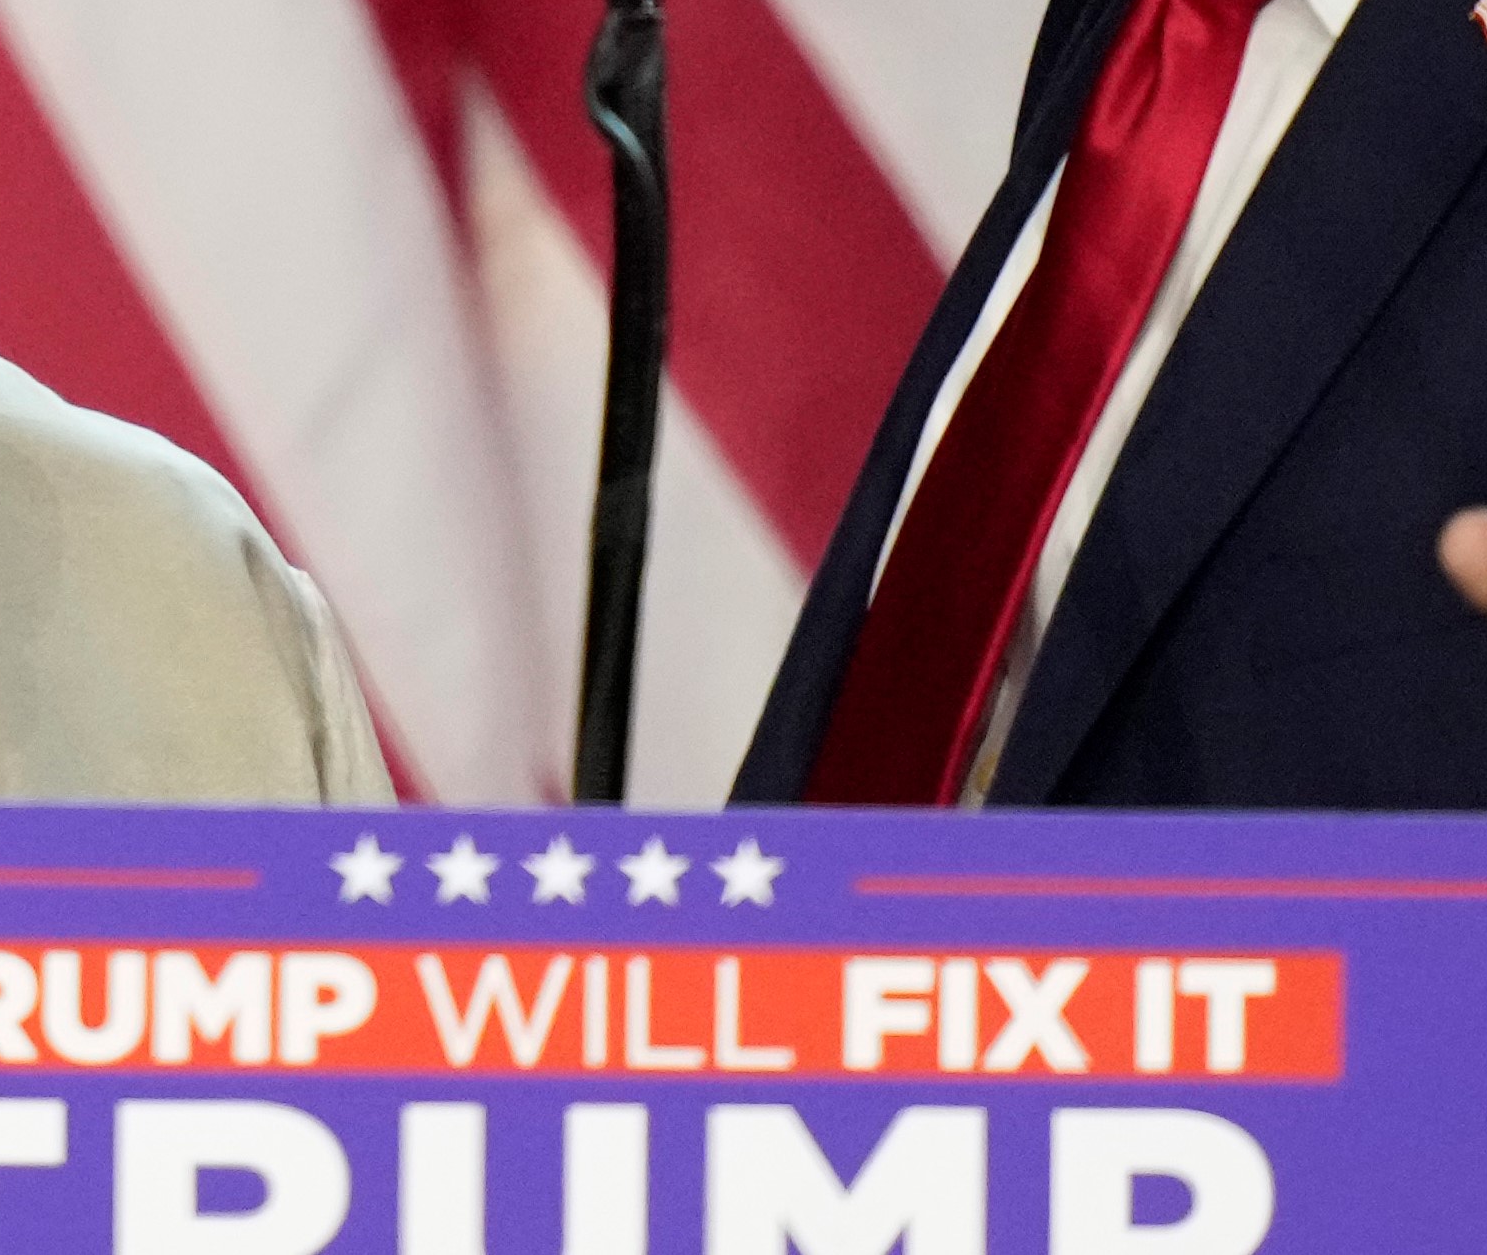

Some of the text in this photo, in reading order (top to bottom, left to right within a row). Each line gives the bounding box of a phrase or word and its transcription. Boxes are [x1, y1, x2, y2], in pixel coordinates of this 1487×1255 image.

[415, 952, 797, 1071] WILL
[841, 956, 1091, 1074] FIX
[1134, 958, 1278, 1075] IT
